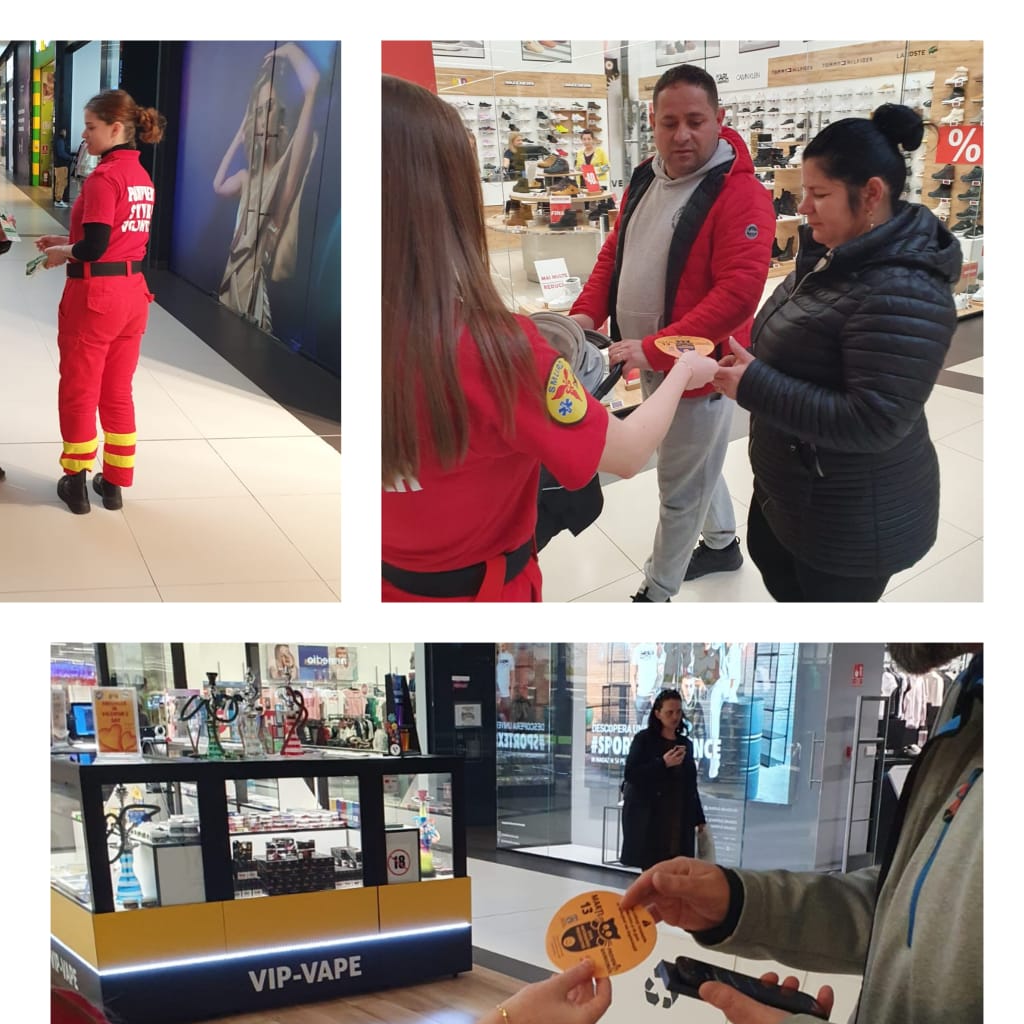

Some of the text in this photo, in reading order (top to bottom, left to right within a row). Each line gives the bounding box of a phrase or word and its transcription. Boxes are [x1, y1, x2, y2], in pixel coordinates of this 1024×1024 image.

[896, 49, 927, 59] LAOSTE
[591, 723, 632, 734] DESCOPERA
[392, 854, 406, 870] 18
[579, 901, 594, 916] 13
[248, 955, 362, 992] VIP-VAPE
